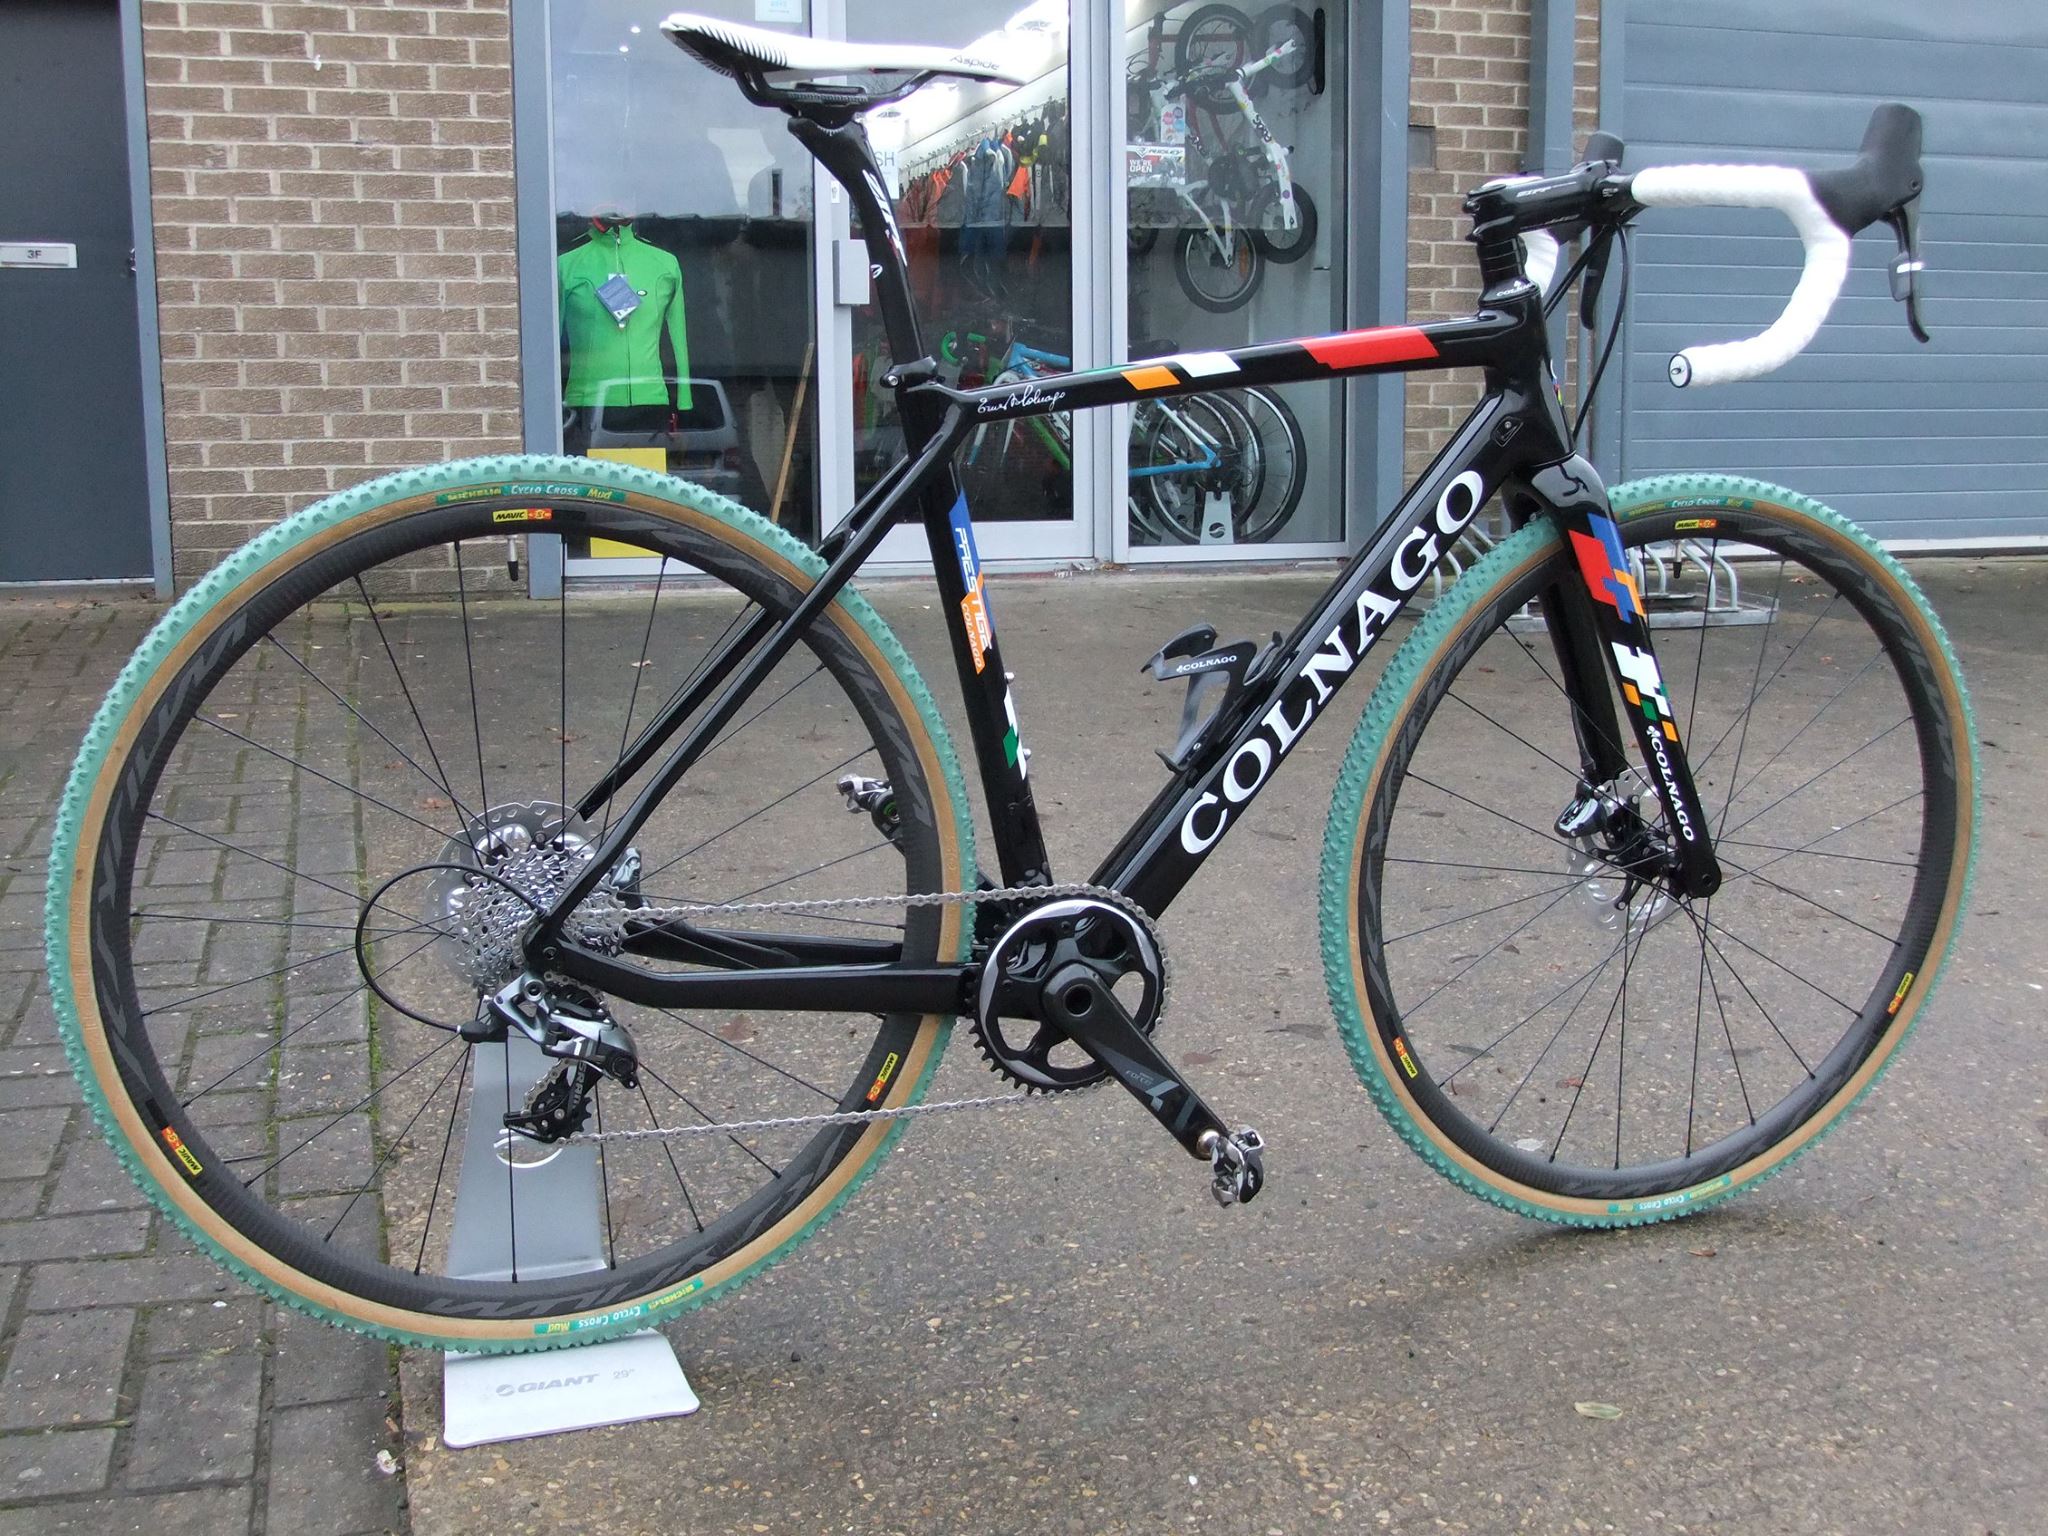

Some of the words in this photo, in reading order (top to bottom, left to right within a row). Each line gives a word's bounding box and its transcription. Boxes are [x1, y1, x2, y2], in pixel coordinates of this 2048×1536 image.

[949, 55, 1000, 71] Aspide
[1129, 165, 1153, 173] OPEN
[27, 249, 42, 259] 3F
[586, 487, 614, 500] Mud
[495, 511, 526, 521] MAVIC
[955, 527, 992, 650] PRESTIGE
[961, 603, 983, 669] COLNAGO
[1180, 470, 1484, 855] COLNAGO
[1182, 655, 1238, 671] COLNAGO
[1651, 737, 1695, 842] COLNAGO
[178, 1148, 201, 1171] MAVIC
[517, 1373, 601, 1393] GIANT
